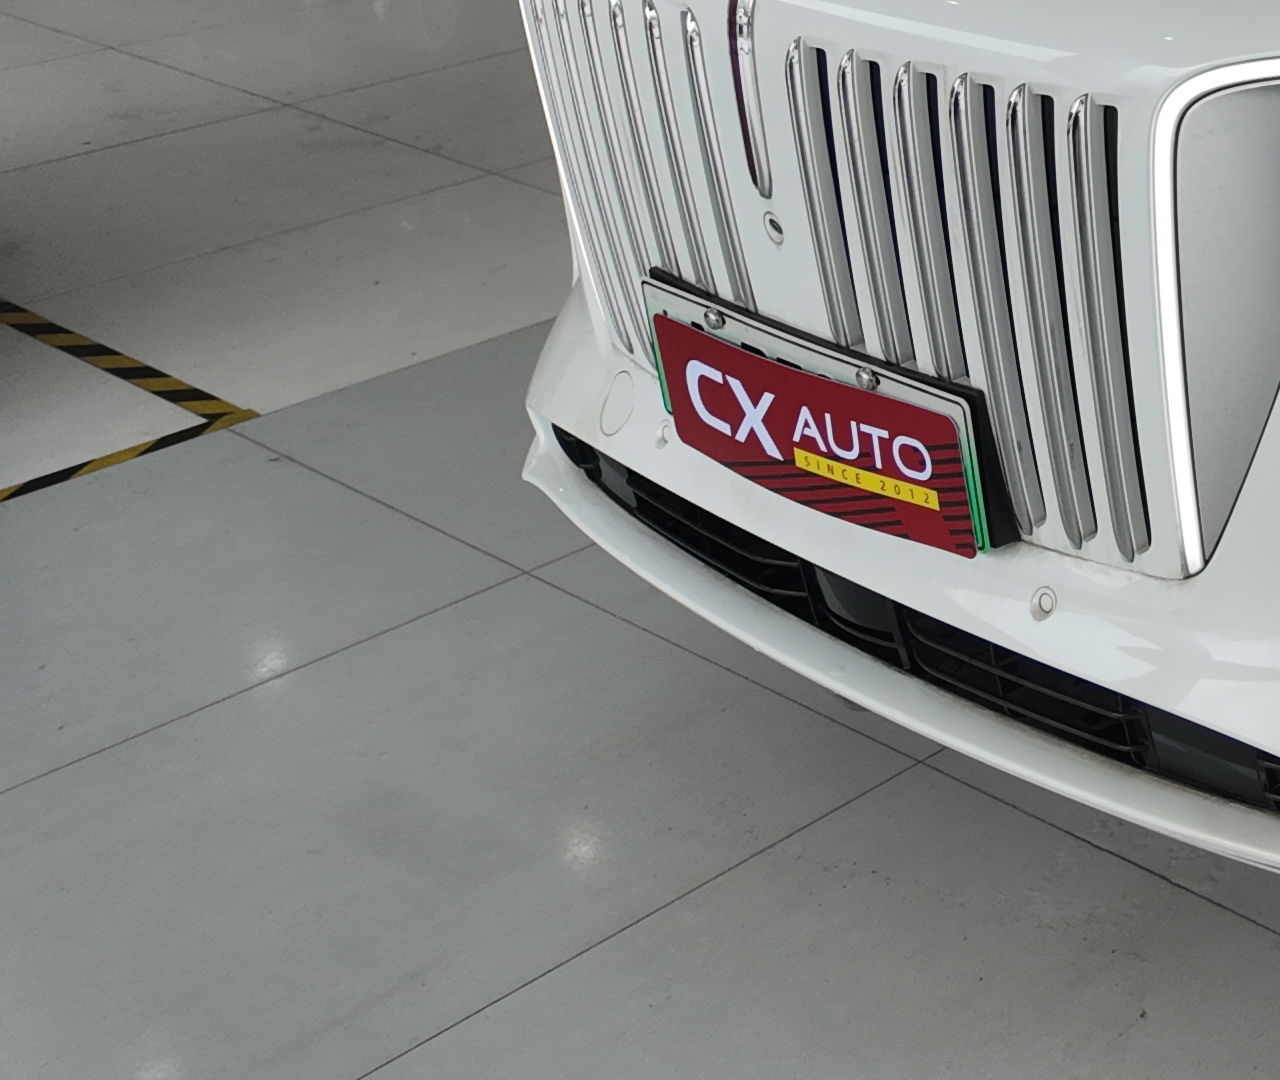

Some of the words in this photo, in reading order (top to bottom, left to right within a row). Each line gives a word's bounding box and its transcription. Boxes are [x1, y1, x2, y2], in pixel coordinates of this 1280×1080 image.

[685, 359, 784, 462] CX
[792, 405, 933, 481] AUTO
[803, 455, 862, 486] SINCE
[879, 479, 931, 505] 2012
